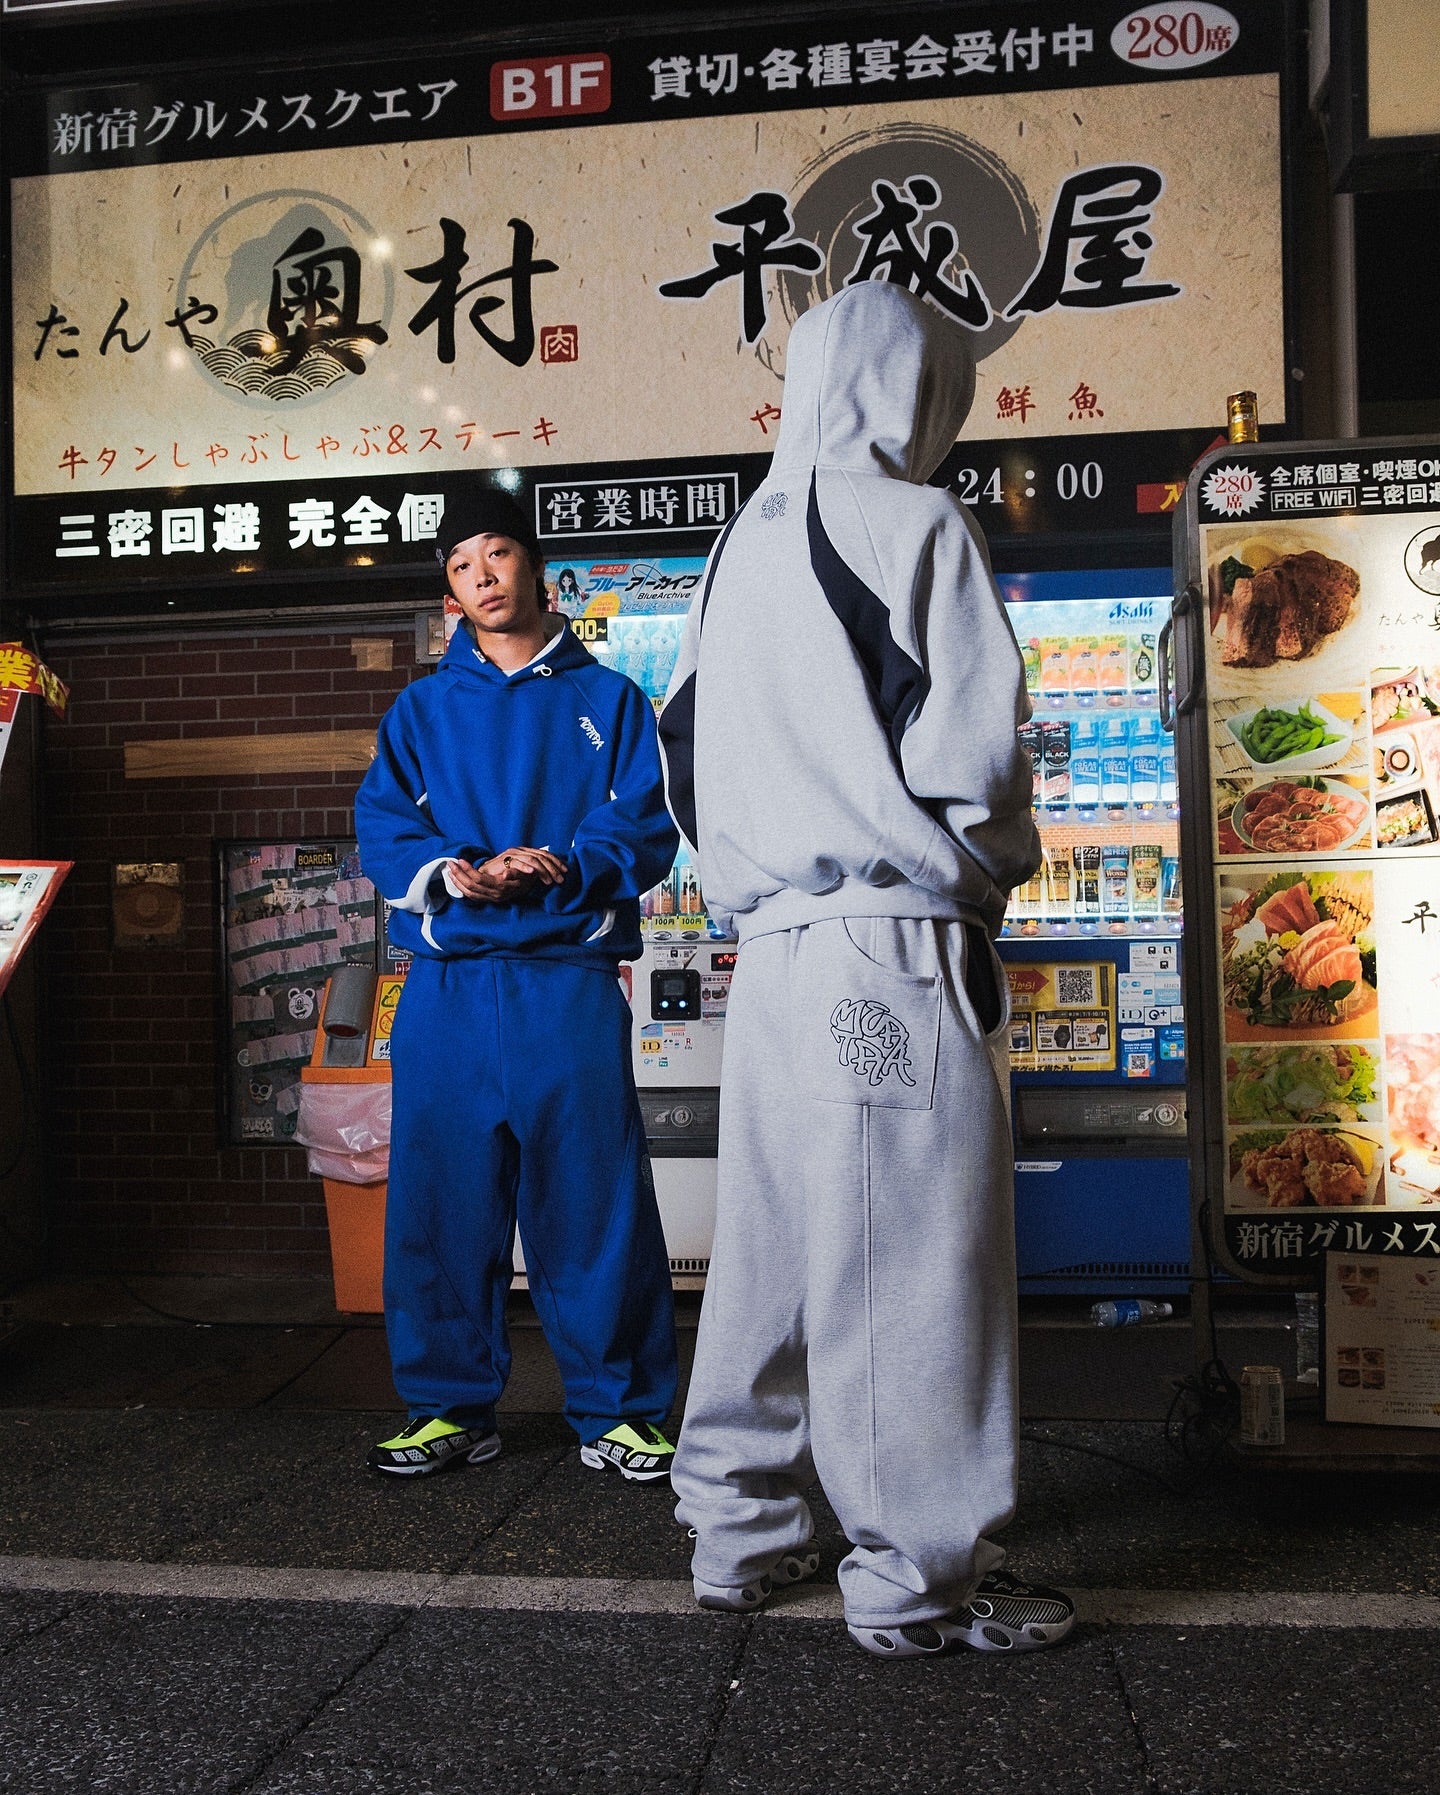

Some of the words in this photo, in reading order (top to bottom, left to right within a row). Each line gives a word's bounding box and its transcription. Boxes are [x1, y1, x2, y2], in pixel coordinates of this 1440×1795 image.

[1127, 12, 1233, 60] 280席
[648, 23, 1094, 101] 貸切・各種宴会受付中
[503, 60, 604, 112] B1F
[53, 79, 459, 155] 新宿グルメスクエア
[996, 382, 1104, 424] 鮮魚
[58, 417, 559, 480] 牛タンしゃぶしゃぶ&ステーキ
[1215, 475, 1253, 493] 280
[1274, 491, 1315, 509] FREE
[547, 482, 726, 531] 営業時間
[55, 501, 261, 558] 三密回避
[585, 575, 702, 592] ブルーアーカイブ
[1109, 602, 1153, 619] Asahi
[297, 853, 333, 865] BOARDER
[655, 918, 675, 926] 100円
[682, 918, 702, 926] 100円
[1236, 1219, 1440, 1259] 新宿グルメス
